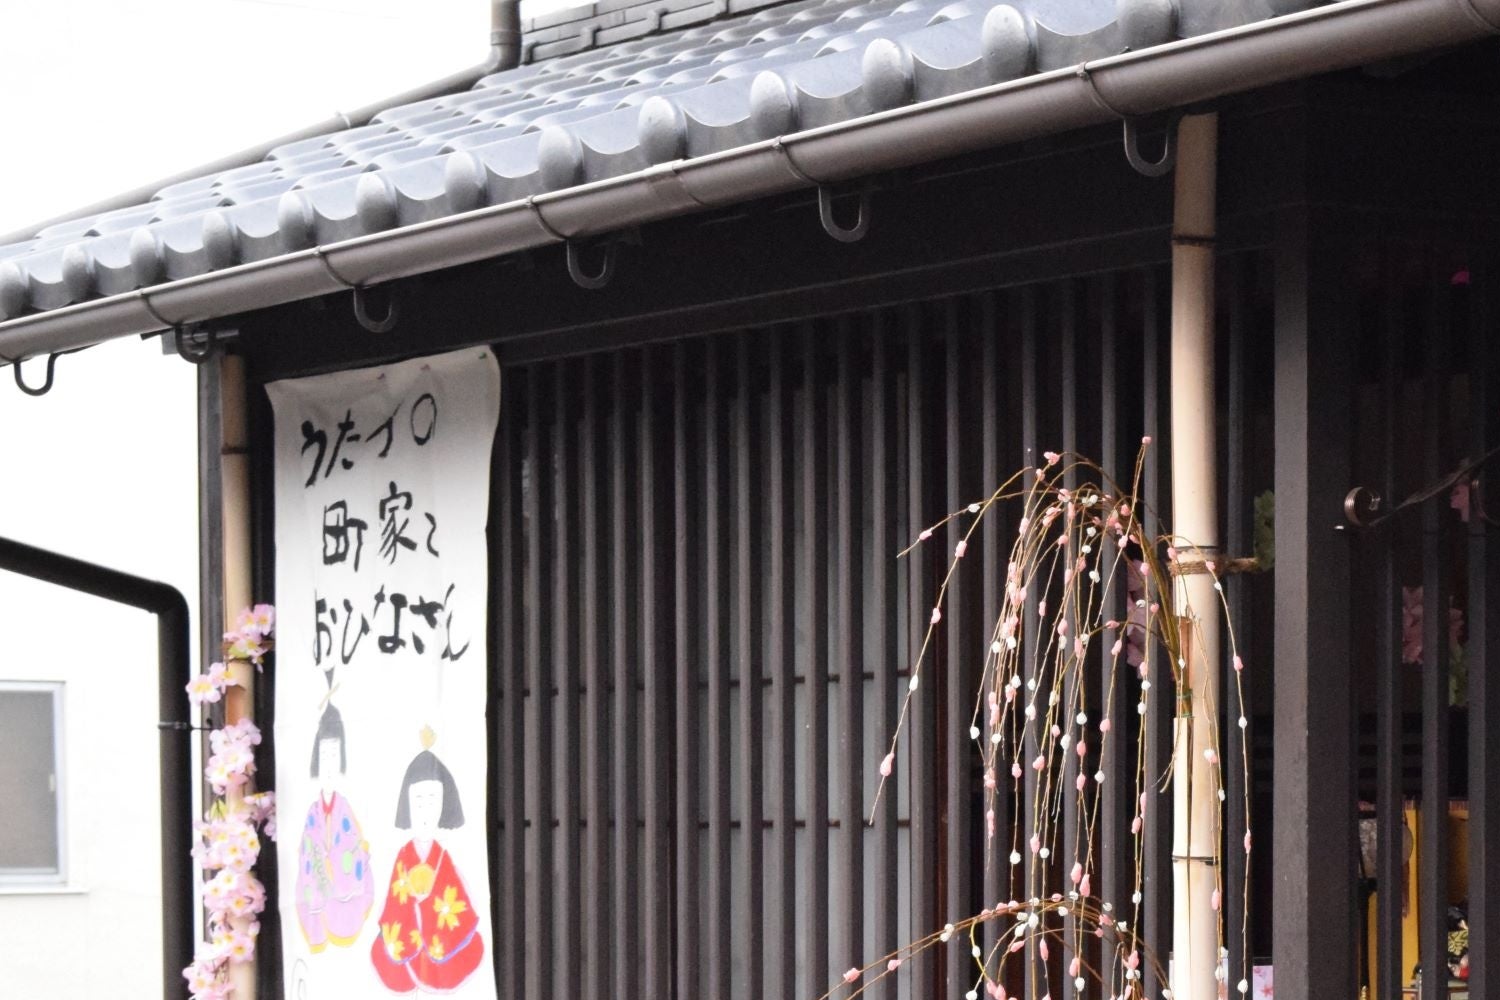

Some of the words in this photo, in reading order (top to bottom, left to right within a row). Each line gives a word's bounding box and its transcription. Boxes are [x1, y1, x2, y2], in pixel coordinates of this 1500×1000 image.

[313, 583, 470, 666] おひなさん
